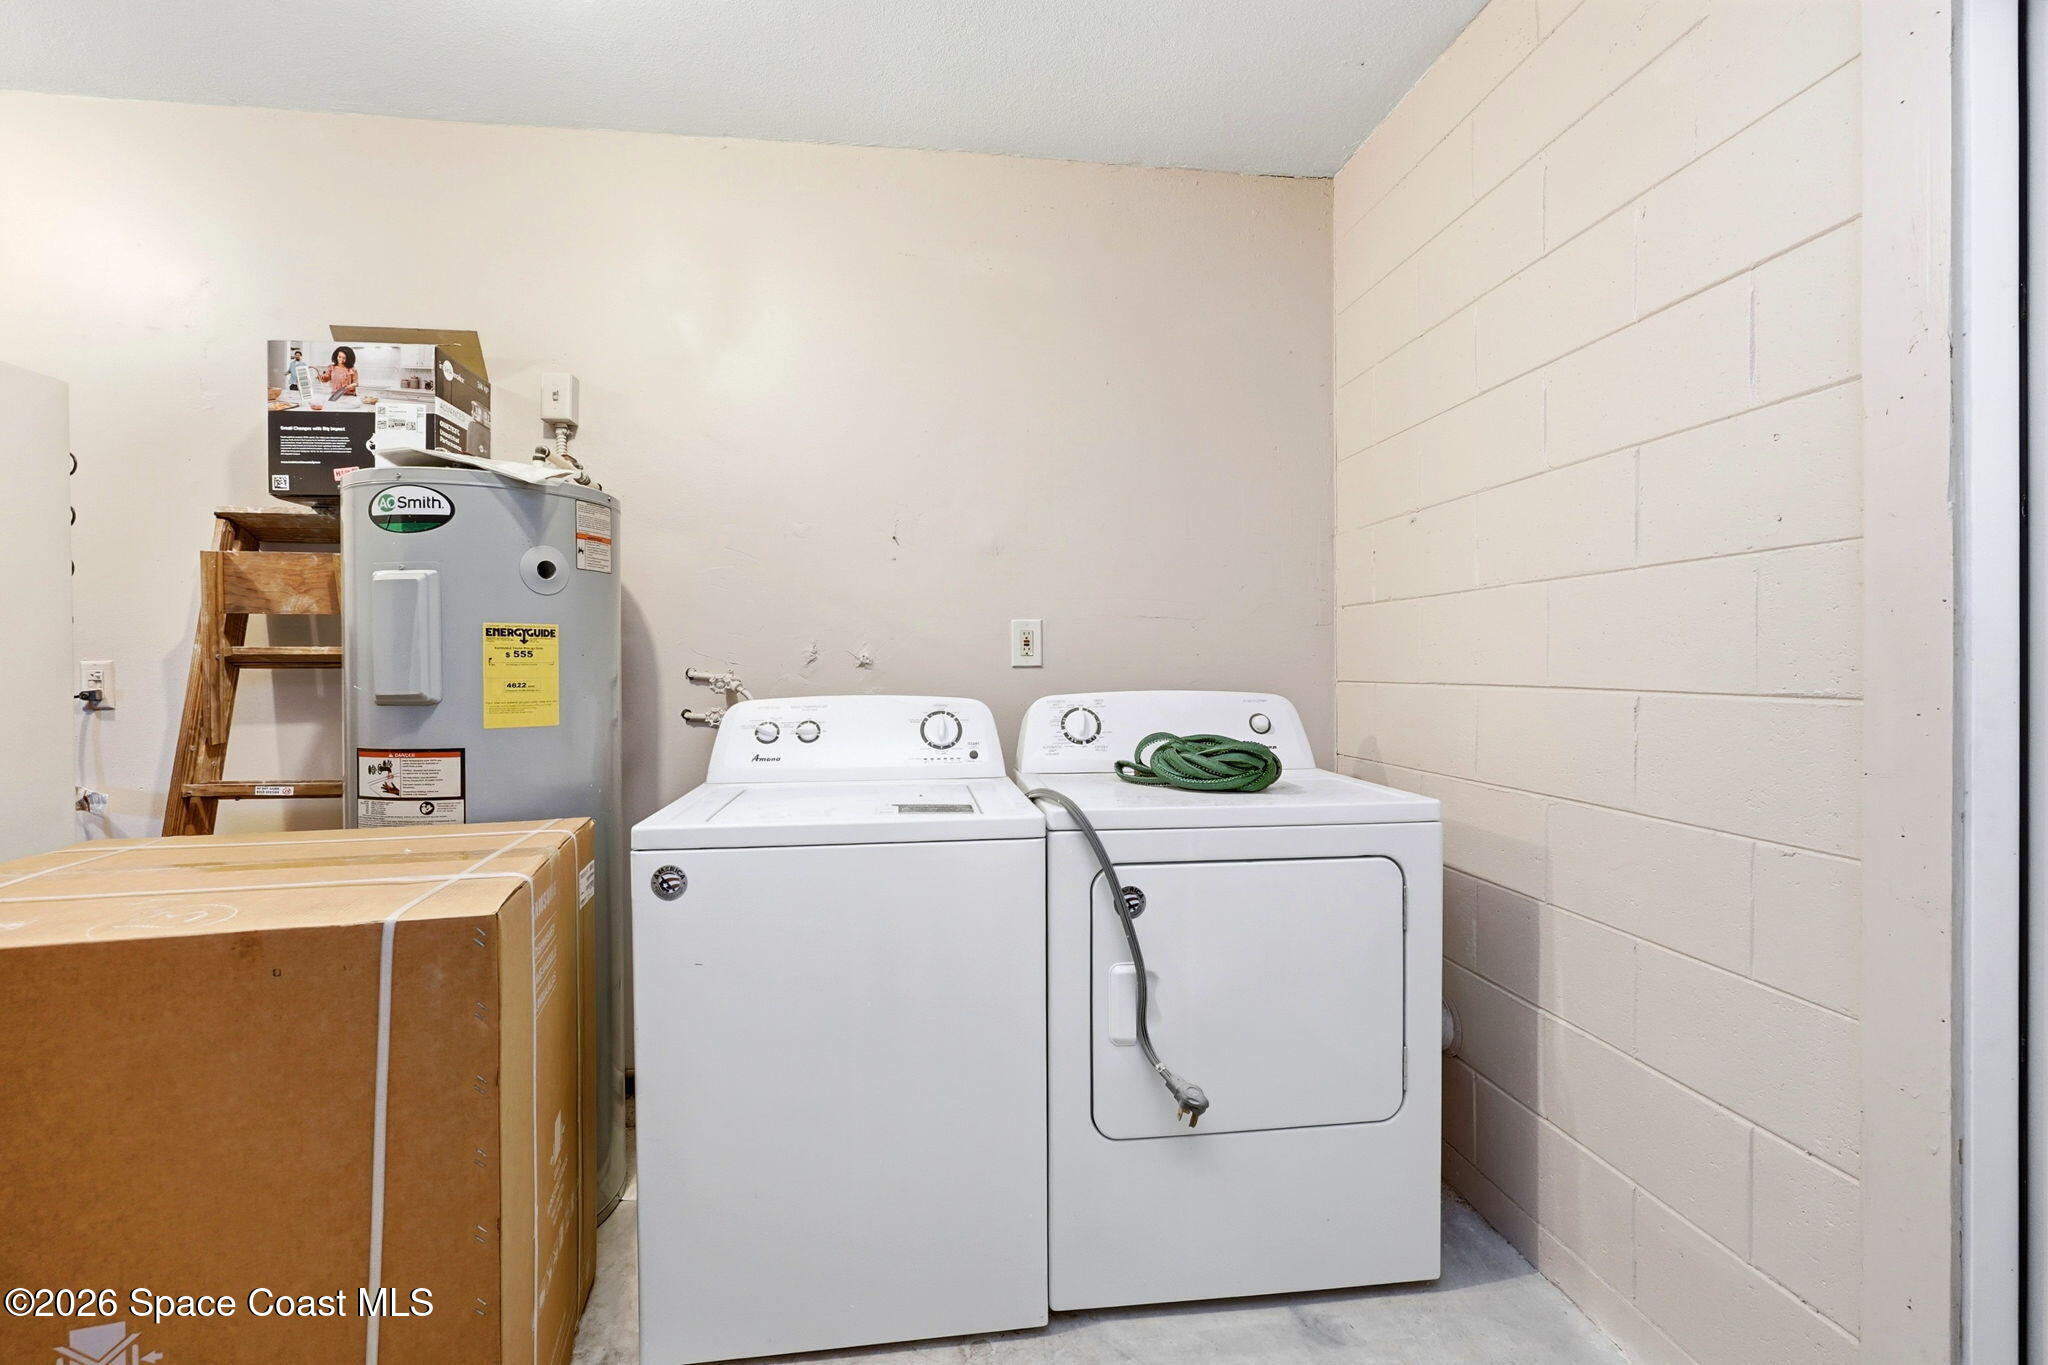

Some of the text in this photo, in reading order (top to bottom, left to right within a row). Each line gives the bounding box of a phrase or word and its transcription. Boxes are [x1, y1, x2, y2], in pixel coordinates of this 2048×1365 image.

[485, 627, 556, 639] ENERGYGUIDE
[513, 650, 534, 658] 555
[751, 754, 781, 762] Amana
[653, 866, 686, 880] AMERICA
